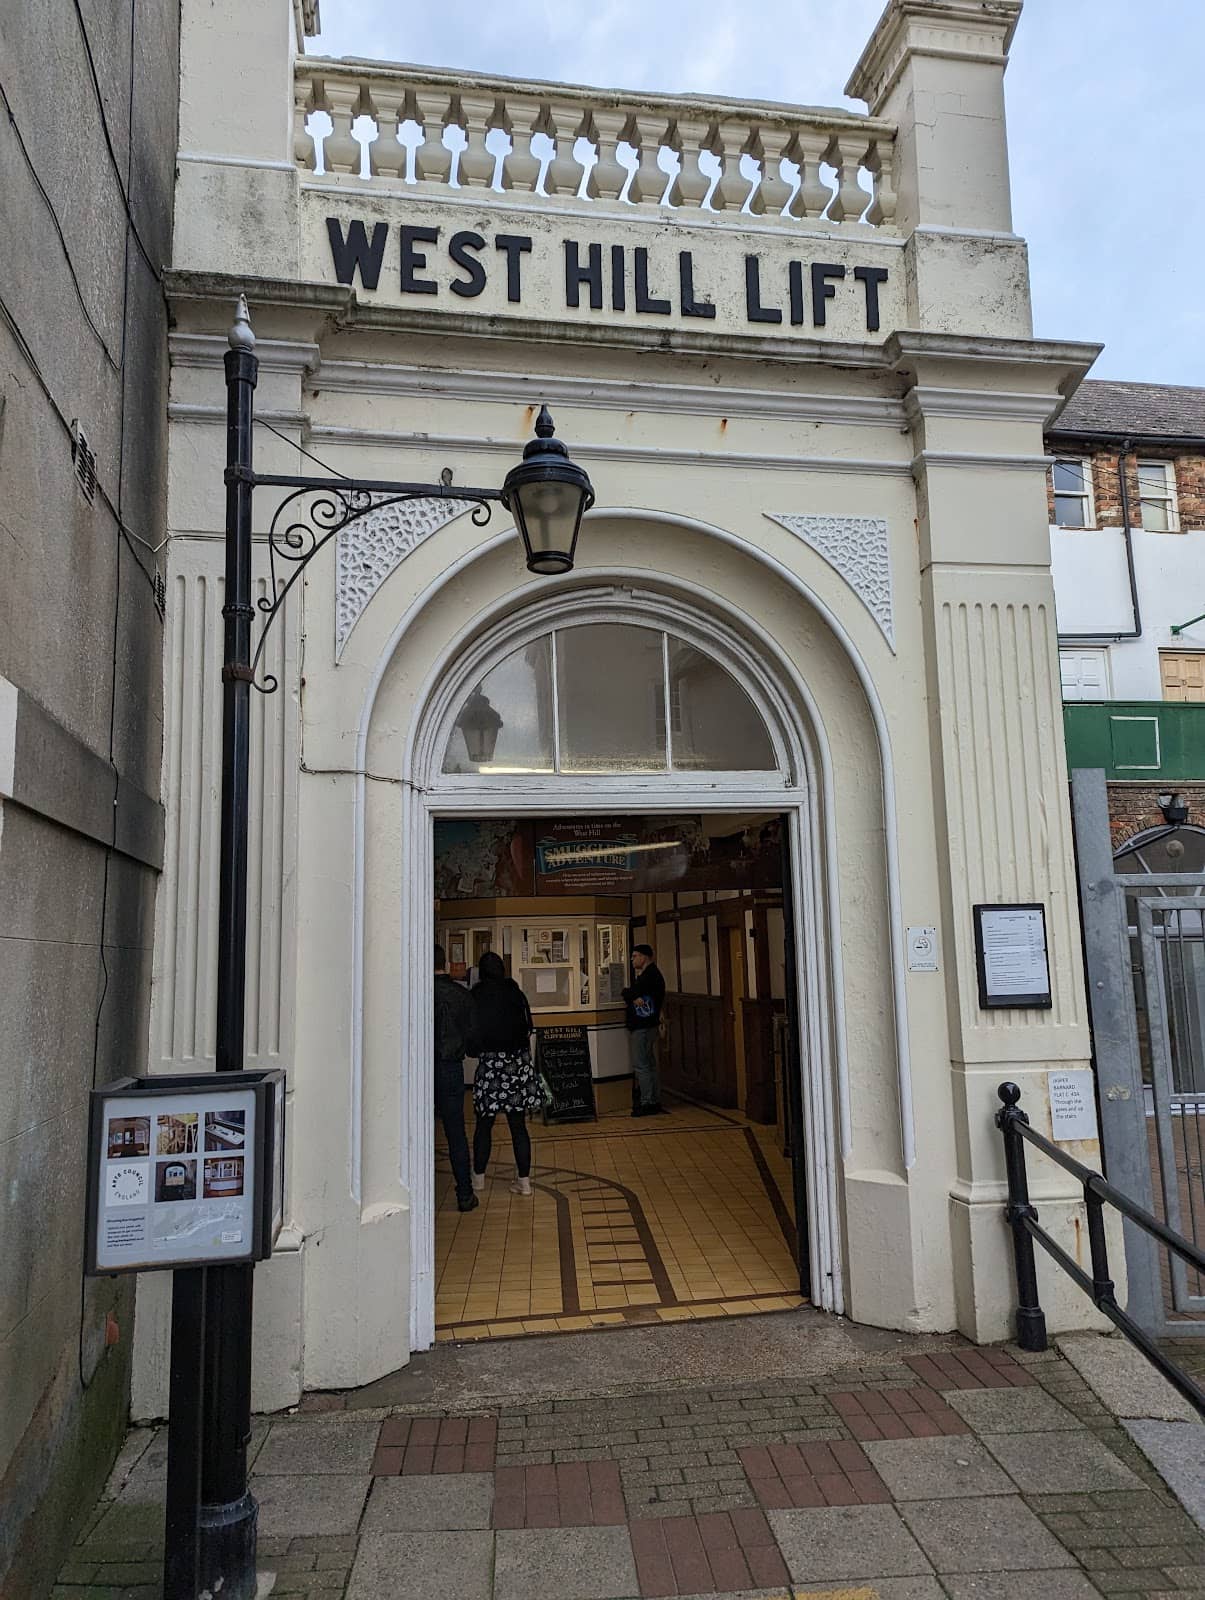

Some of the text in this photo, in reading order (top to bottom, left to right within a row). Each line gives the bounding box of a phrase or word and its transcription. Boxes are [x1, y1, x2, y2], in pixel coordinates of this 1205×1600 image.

[326, 217, 889, 331] WEST HILL LIFT
[123, 1169, 144, 1187] COUNCIL
[114, 1189, 140, 1200] ENGLAND
